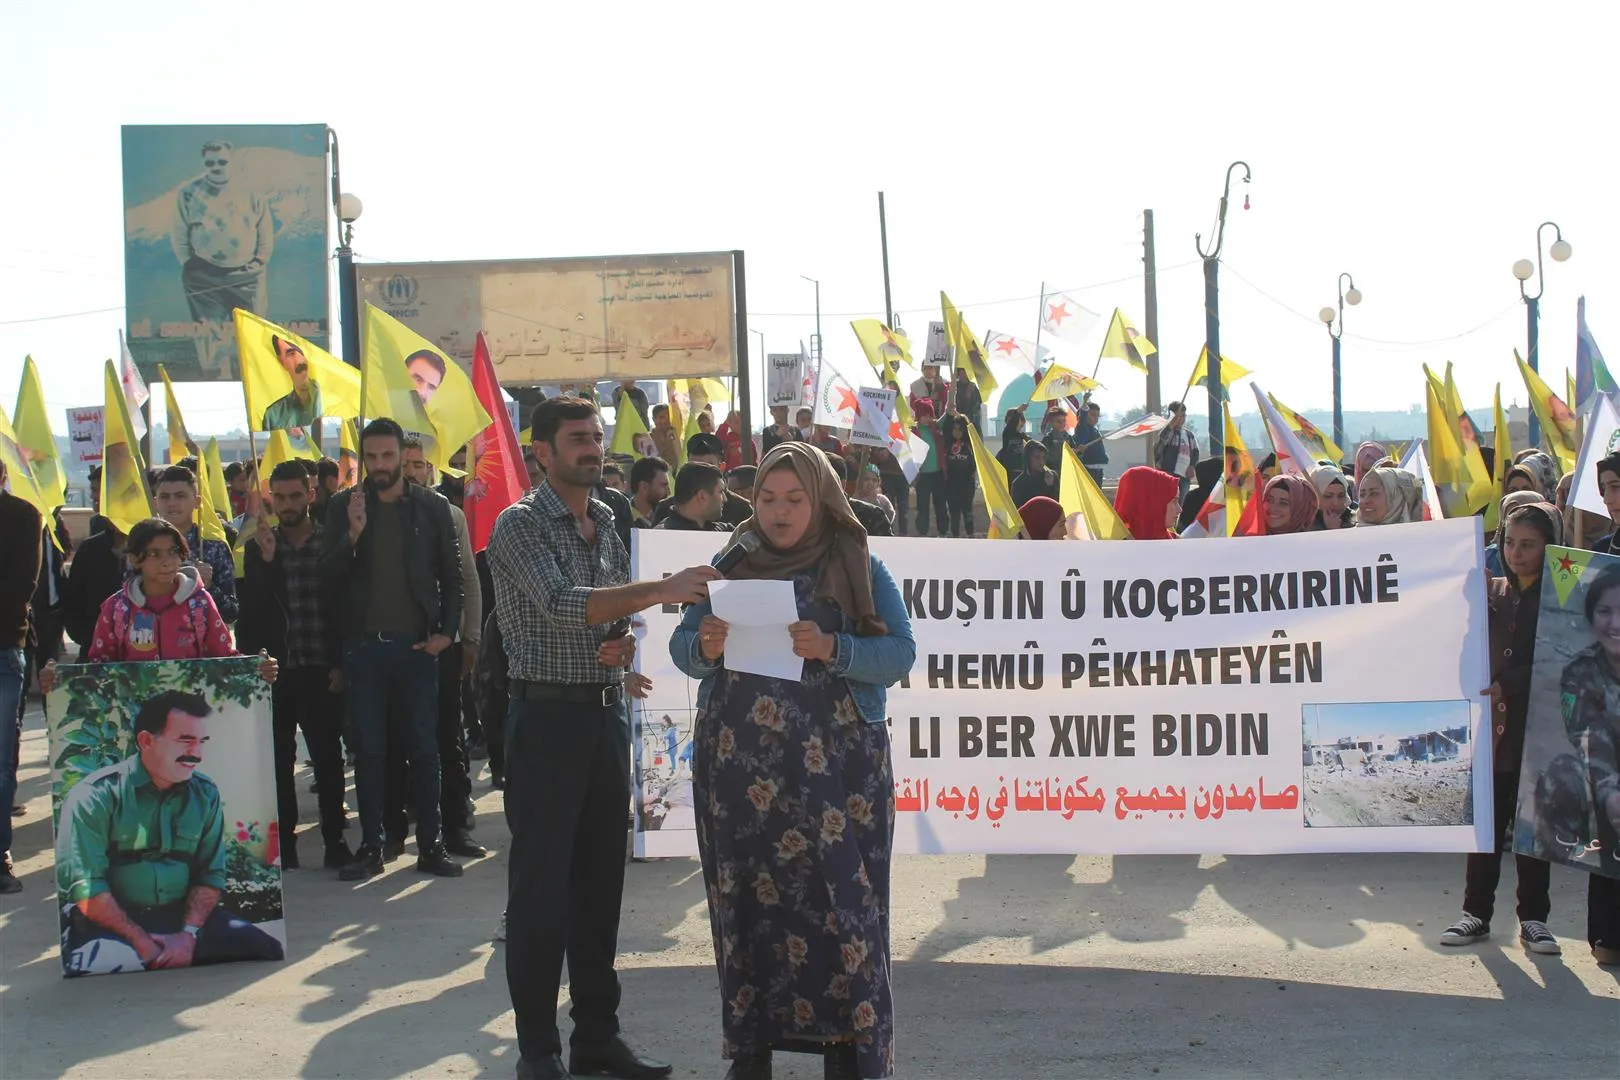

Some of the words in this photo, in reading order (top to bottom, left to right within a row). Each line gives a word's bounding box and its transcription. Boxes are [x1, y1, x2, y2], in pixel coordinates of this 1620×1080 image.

[902, 579, 1044, 628] KUŞTIN
[1061, 569, 1086, 620] Û
[1103, 553, 1399, 622] KOÇBERKIRINÊ
[928, 640, 1044, 690] HEMÛ
[1061, 630, 1323, 688] PÊKHATEYÊN
[909, 716, 941, 758] LI
[958, 716, 1036, 758] BER
[1048, 715, 1136, 758] XWE
[1152, 713, 1269, 757] BIDIN
[935, 784, 980, 821] وجه
[985, 775, 1009, 828] في
[1014, 775, 1106, 821] مكوناتنا
[1114, 784, 1187, 821] بجميع
[1193, 775, 1299, 821] صامدون
